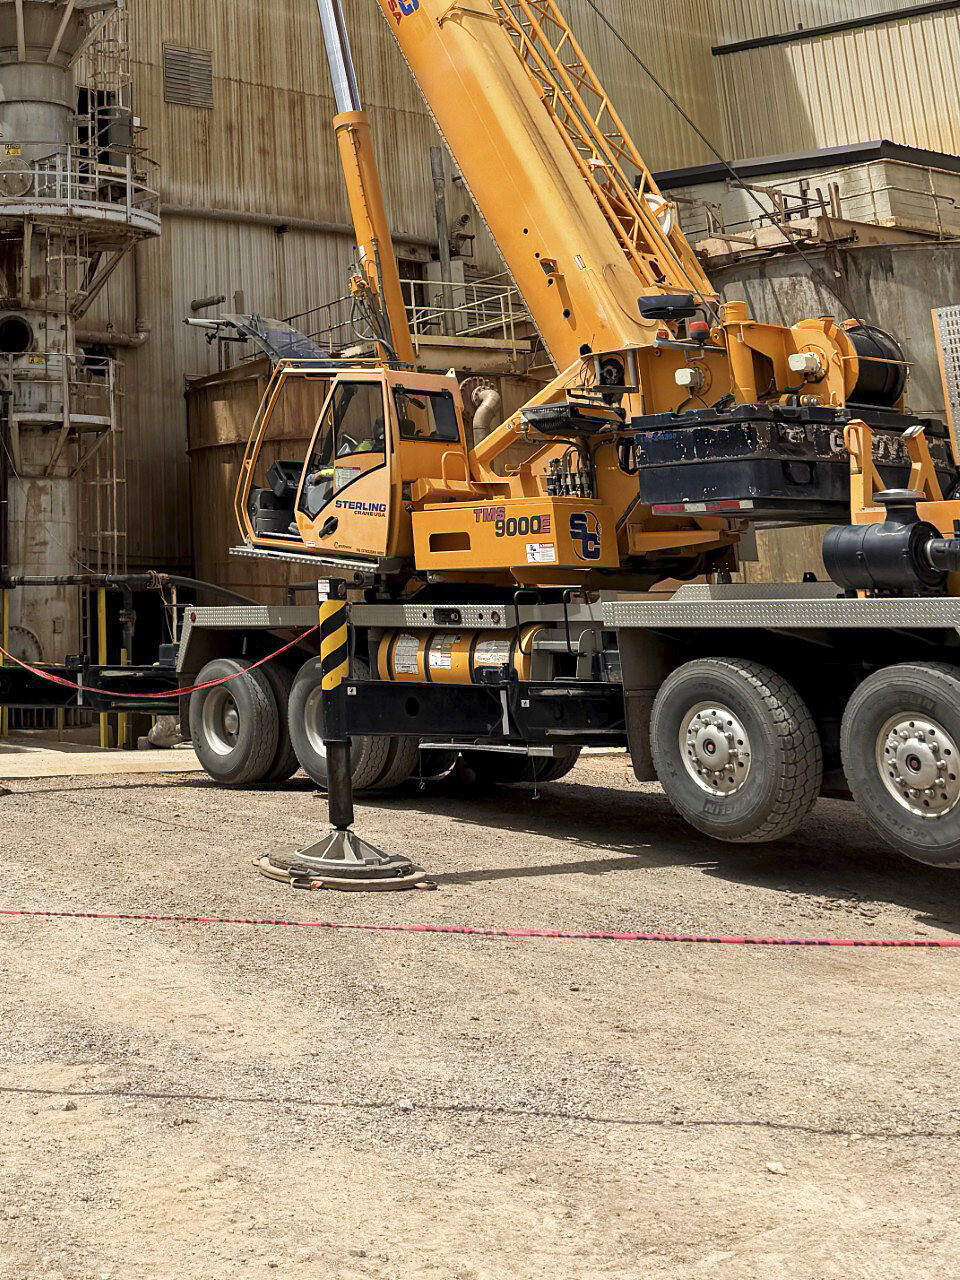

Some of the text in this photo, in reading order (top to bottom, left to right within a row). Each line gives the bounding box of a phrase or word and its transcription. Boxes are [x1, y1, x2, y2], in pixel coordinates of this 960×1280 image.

[335, 500, 386, 513] STERLING
[474, 506, 505, 522] TMS
[495, 515, 550, 537] 9000E
